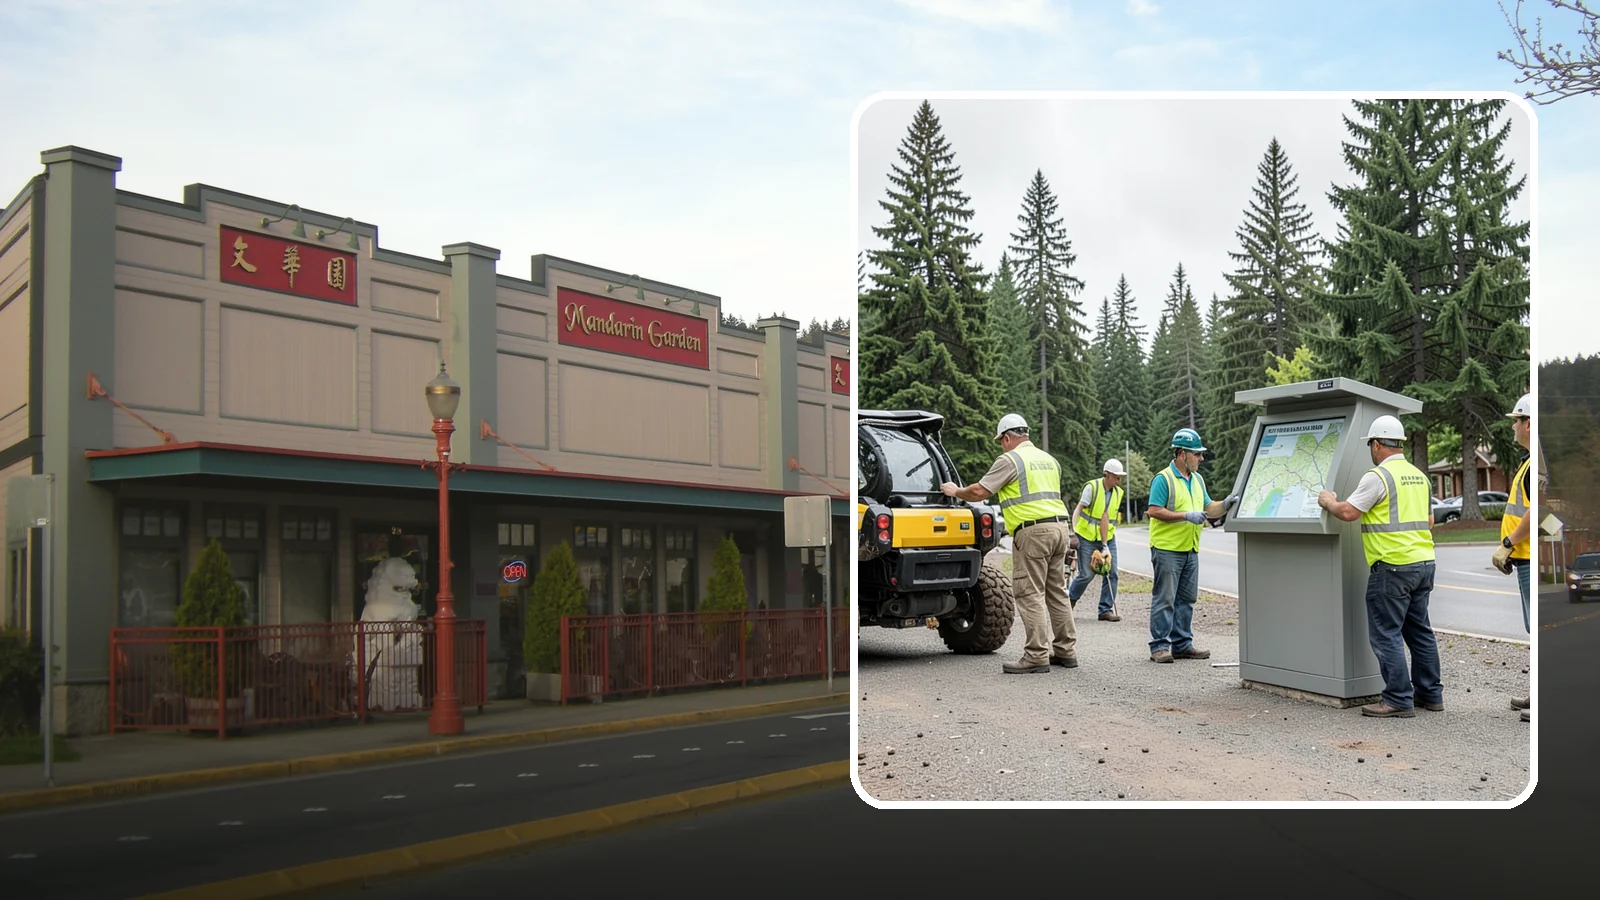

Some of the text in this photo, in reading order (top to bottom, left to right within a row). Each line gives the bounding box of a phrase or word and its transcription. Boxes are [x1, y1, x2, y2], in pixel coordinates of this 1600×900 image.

[564, 302, 702, 352] Mandarin Garden
[503, 565, 527, 578] OPEN
